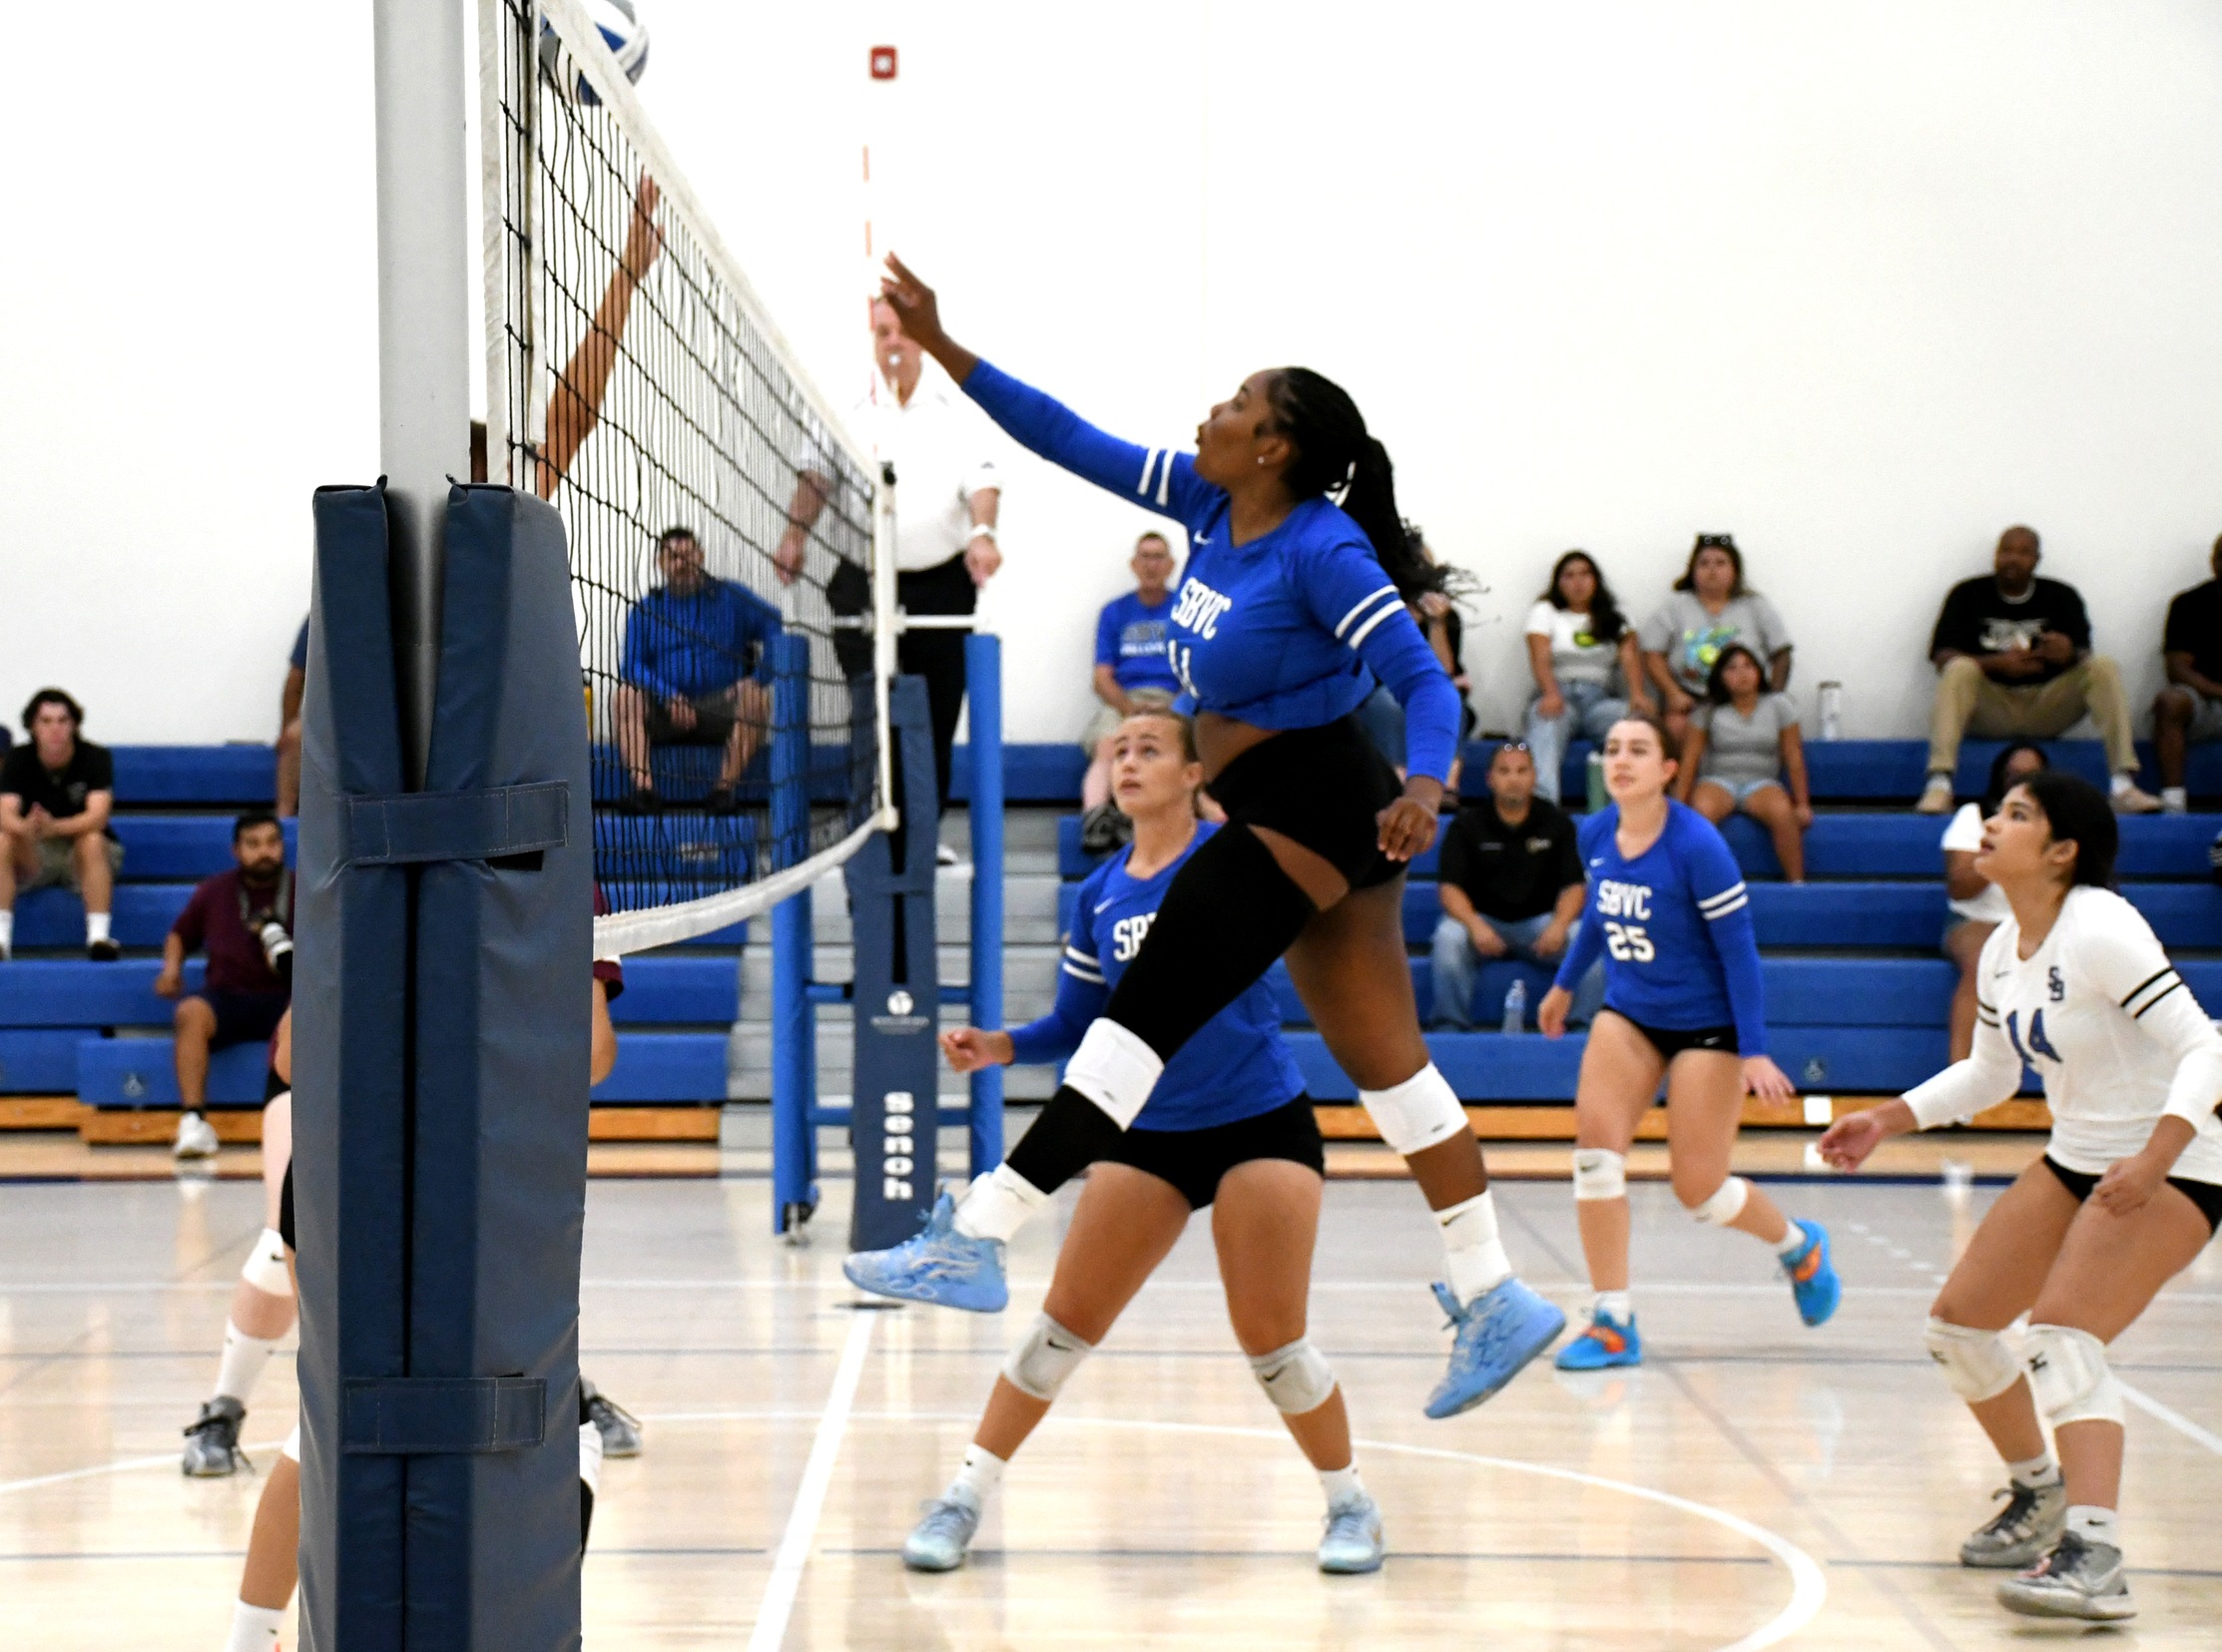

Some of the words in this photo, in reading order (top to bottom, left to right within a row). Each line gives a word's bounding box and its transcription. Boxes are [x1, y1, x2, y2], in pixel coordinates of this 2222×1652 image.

[1170, 577, 1232, 640] SBVC
[1596, 879, 1652, 920] SBVC
[1603, 920, 1655, 963] 25
[2006, 1007, 2063, 1064] 14
